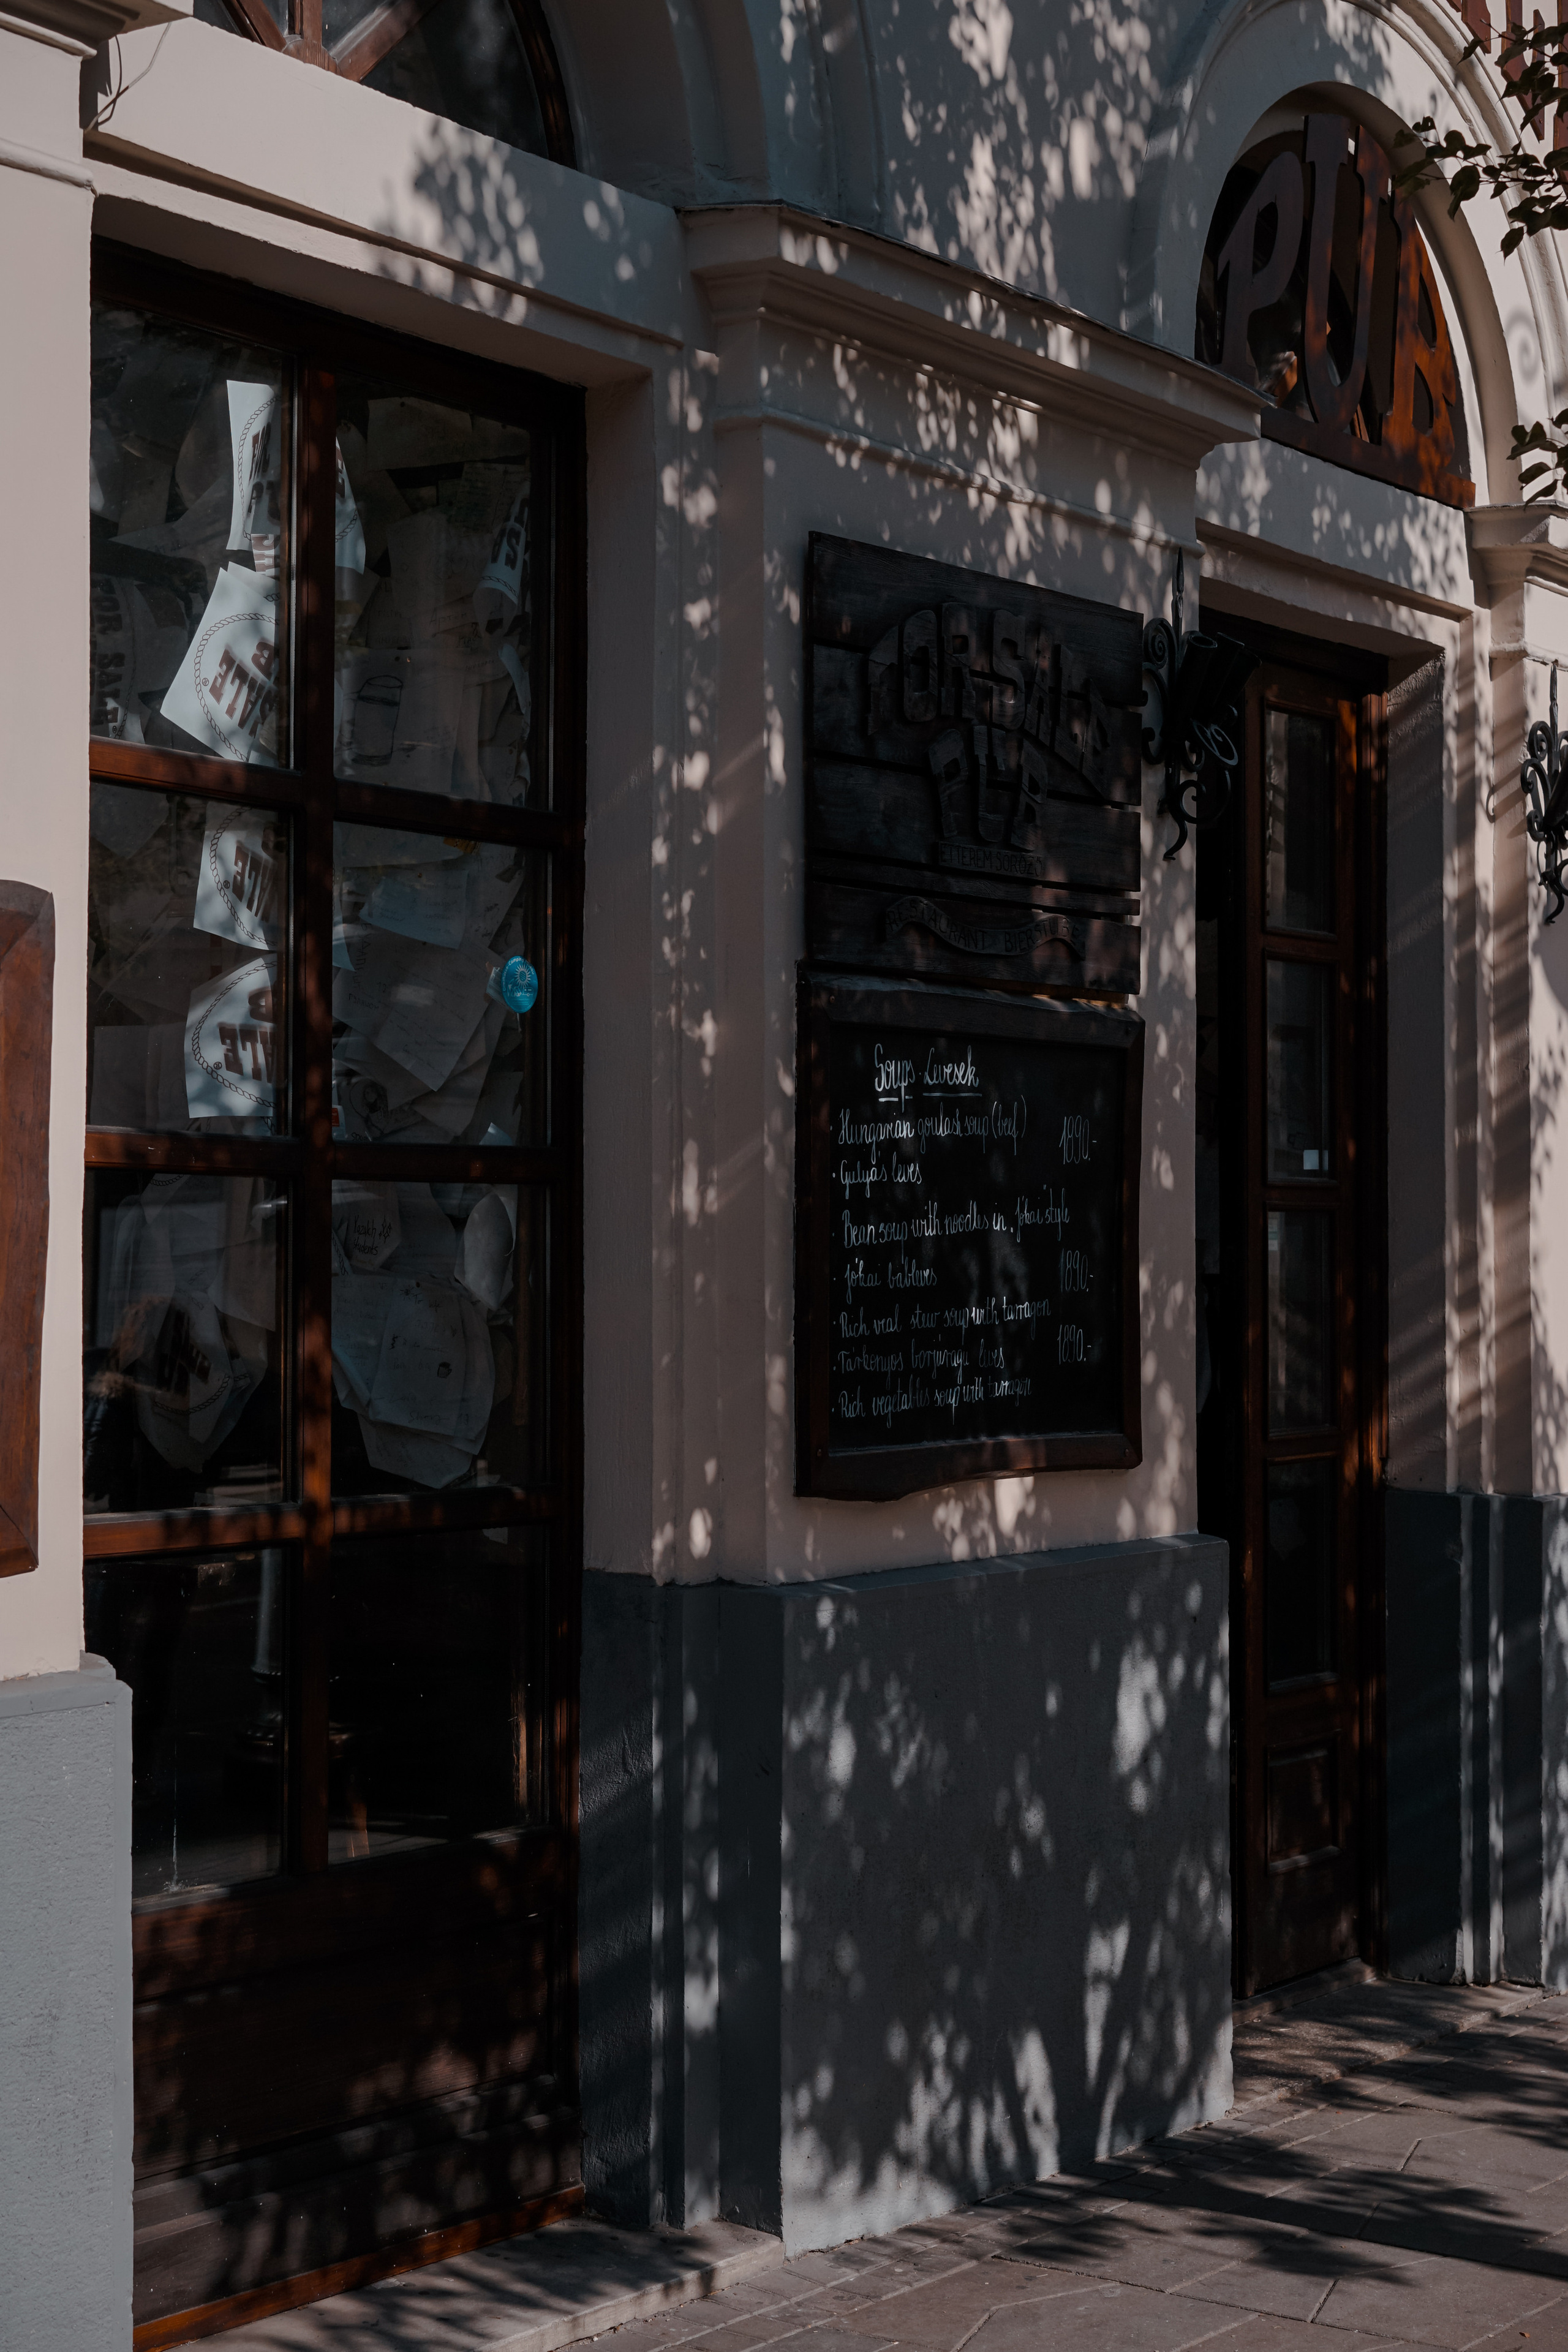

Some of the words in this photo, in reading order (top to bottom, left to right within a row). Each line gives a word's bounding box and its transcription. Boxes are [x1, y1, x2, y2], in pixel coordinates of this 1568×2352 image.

[1218, 113, 1456, 469] PUB
[926, 725, 1049, 851] PUB
[885, 899, 987, 950] RESTAURANT
[1004, 916, 1080, 952] BIERSTUBE
[874, 1043, 916, 1114] Soups
[923, 1044, 980, 1088] Levesek
[838, 1108, 915, 1164] Hungarian
[917, 1101, 963, 1154] goulash
[963, 1115, 989, 1154] soup
[991, 1095, 1027, 1156] (beef)
[840, 1150, 888, 1200] Gulyás
[892, 1152, 922, 1185] leves
[353, 1235, 379, 1256] students
[842, 1209, 877, 1248] Bean
[879, 1220, 908, 1264] soup
[911, 1200, 943, 1238] with
[944, 1200, 989, 1235] noodles
[992, 1202, 1008, 1231] in
[1045, 1188, 1070, 1242] style
[844, 1257, 881, 1305] Jókai
[888, 1256, 937, 1289] bableves
[839, 1306, 870, 1338] Rich
[873, 1303, 902, 1335] veal
[910, 1303, 941, 1330] stew
[943, 1306, 970, 1346] soup
[971, 1296, 1000, 1326] with
[1001, 1295, 1052, 1341] tarragon
[837, 1344, 903, 1390] Tárkonyos
[979, 1338, 1005, 1368] leves
[838, 1385, 866, 1418] Rich
[872, 1374, 930, 1428] vegetables
[933, 1385, 960, 1425] soup
[962, 1376, 984, 1404] with
[987, 1376, 1032, 1407] tarragon
